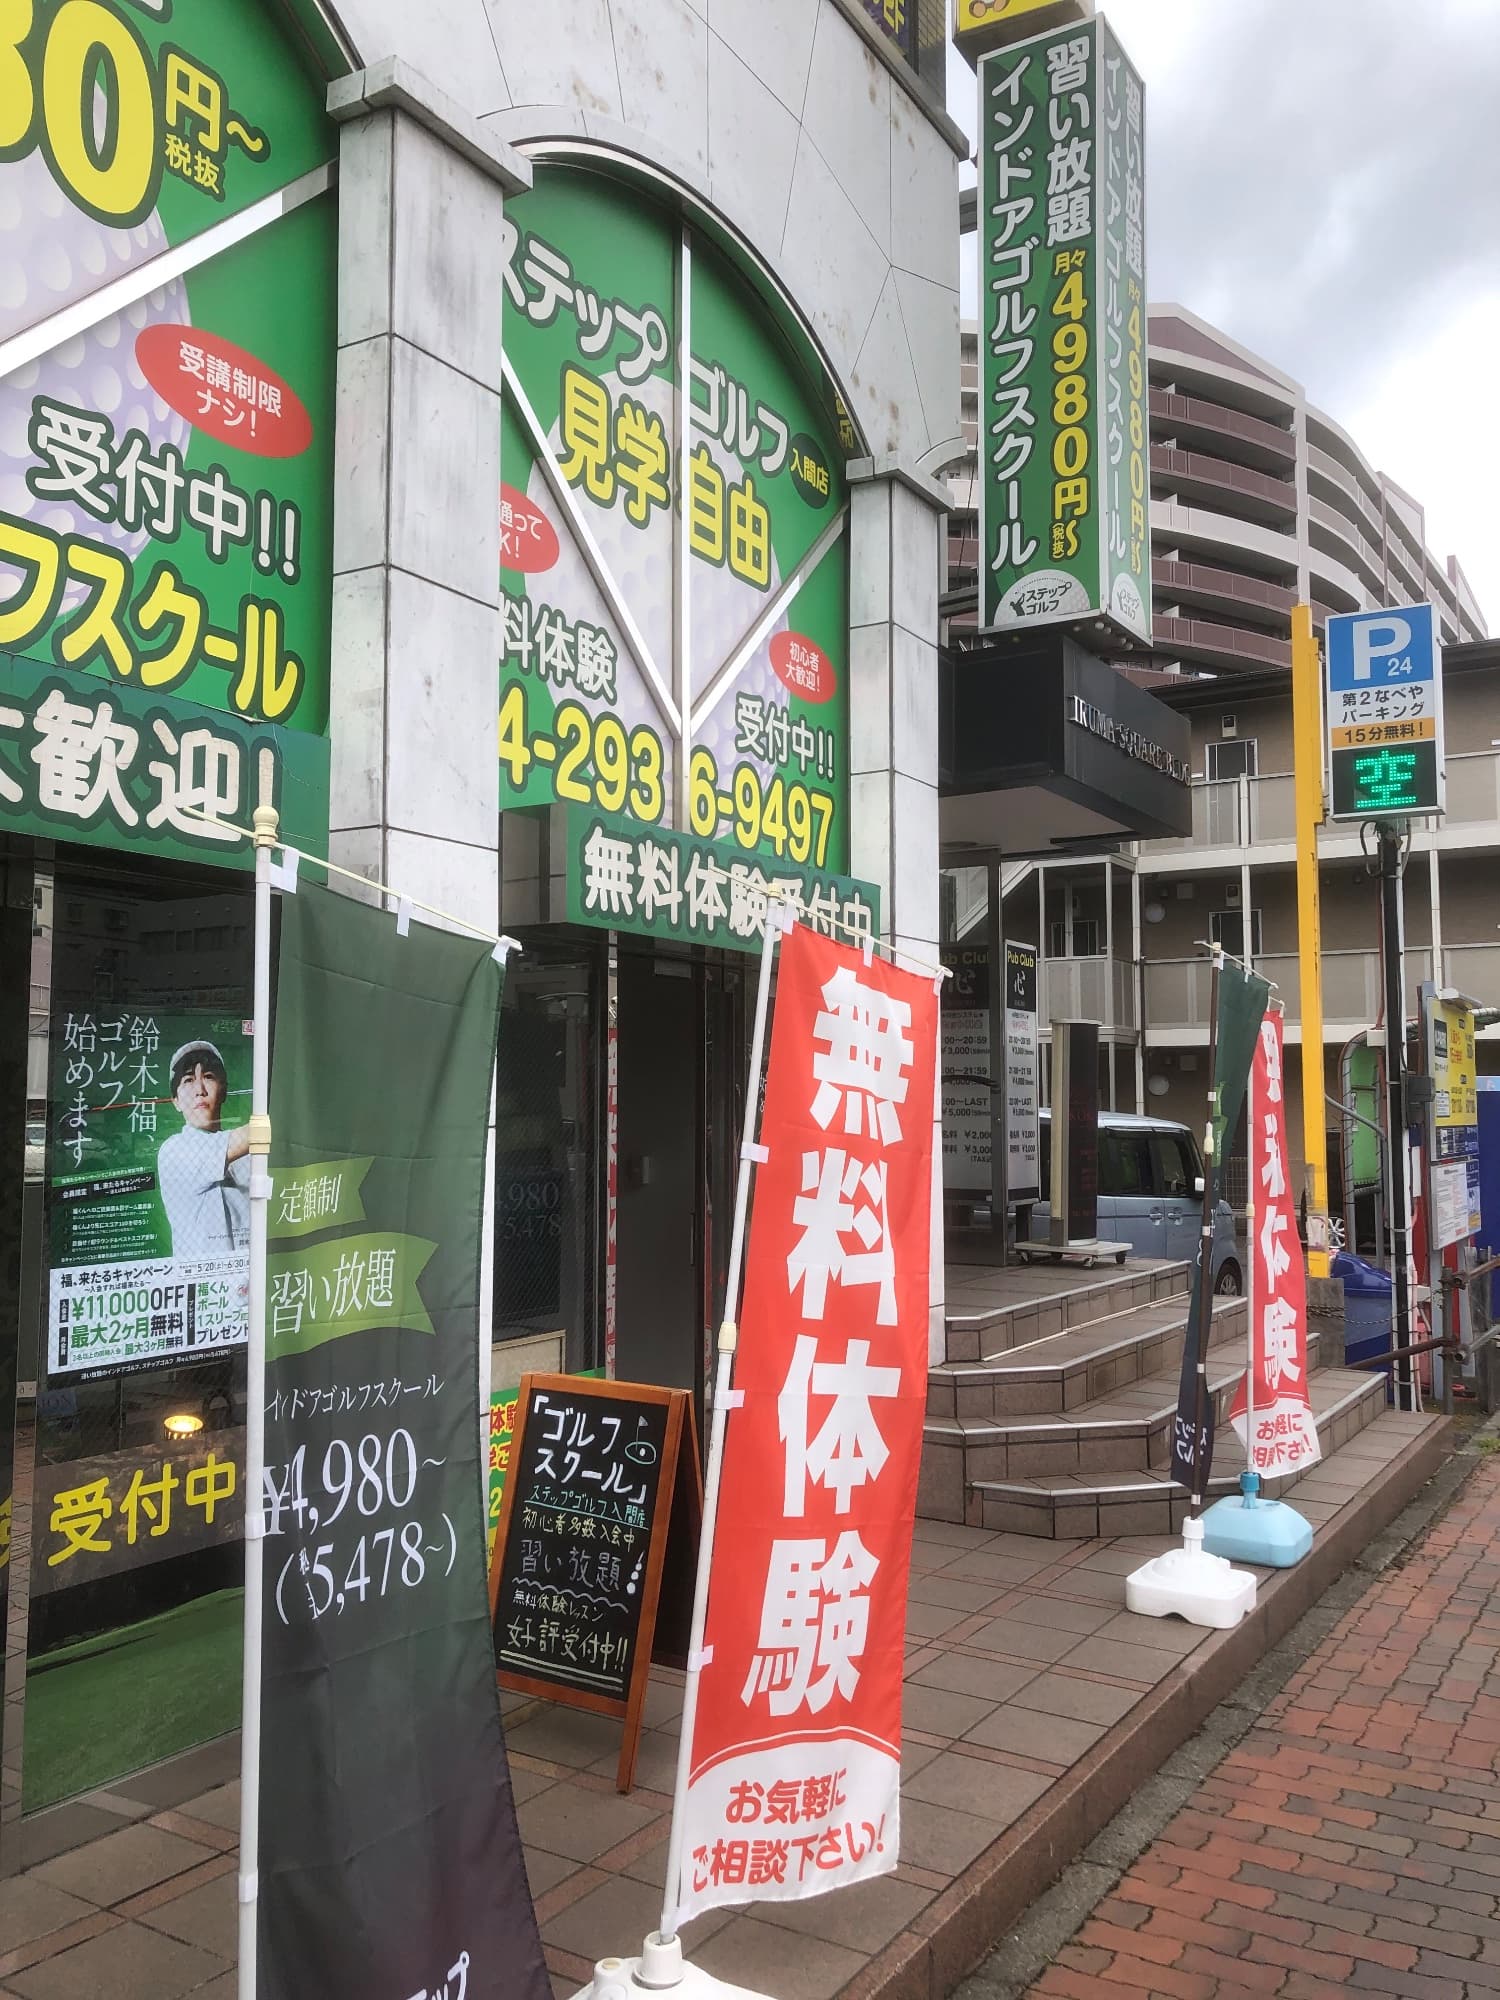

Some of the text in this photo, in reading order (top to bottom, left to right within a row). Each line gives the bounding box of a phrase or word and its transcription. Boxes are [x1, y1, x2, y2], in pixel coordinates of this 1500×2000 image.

[165, 133, 220, 193] 税抜
[1046, 35, 1091, 246] 習い放題
[992, 55, 1037, 571] インドアゴルフスクール
[179, 342, 282, 418] 受講制限
[196, 390, 258, 437] ナシ!
[33, 405, 296, 577] 受付中!!
[790, 447, 829, 495] 入間店
[1025, 599, 1060, 616] ゴルフ
[1026, 582, 1072, 599] ステップ
[788, 641, 820, 672] 初心者
[1353, 616, 1412, 681] P
[1387, 656, 1413, 677] 24
[784, 661, 820, 693] 大歓迎!
[1342, 685, 1424, 707] 第2なべや
[1072, 695, 1116, 744] IRUMA
[1342, 701, 1425, 724] パーキング
[1344, 722, 1424, 744] 15分無料!
[737, 697, 834, 779] 受付中!!
[1355, 750, 1417, 808] 空
[1007, 950, 1035, 968] Pub Club
[98, 1013, 128, 1110] ゴルフ
[128, 1016, 160, 1142] 鈴木福、
[59, 1012, 97, 1168] 始めます
[276, 1173, 342, 1225] 定額制
[61, 1264, 173, 1289] 福、来たるキャンペーン
[197, 1280, 229, 1297] 福くん
[271, 1248, 397, 1338] 習い放題
[198, 1296, 229, 1311] ボール
[71, 1311, 184, 1349] 最大2ヶ月無料
[740, 967, 914, 1718] 無料体験
[47, 1453, 236, 1567] 受付中
[522, 1506, 635, 1552] 初心者多数入会中
[530, 1483, 646, 1528] ステップゴルフ入間店
[512, 1588, 604, 1620] 無料体験レッスン
[507, 1614, 629, 1672] 好評受付中!!
[725, 1769, 847, 1825] お気軽に
[692, 1813, 886, 1893] ご相談下さい!
